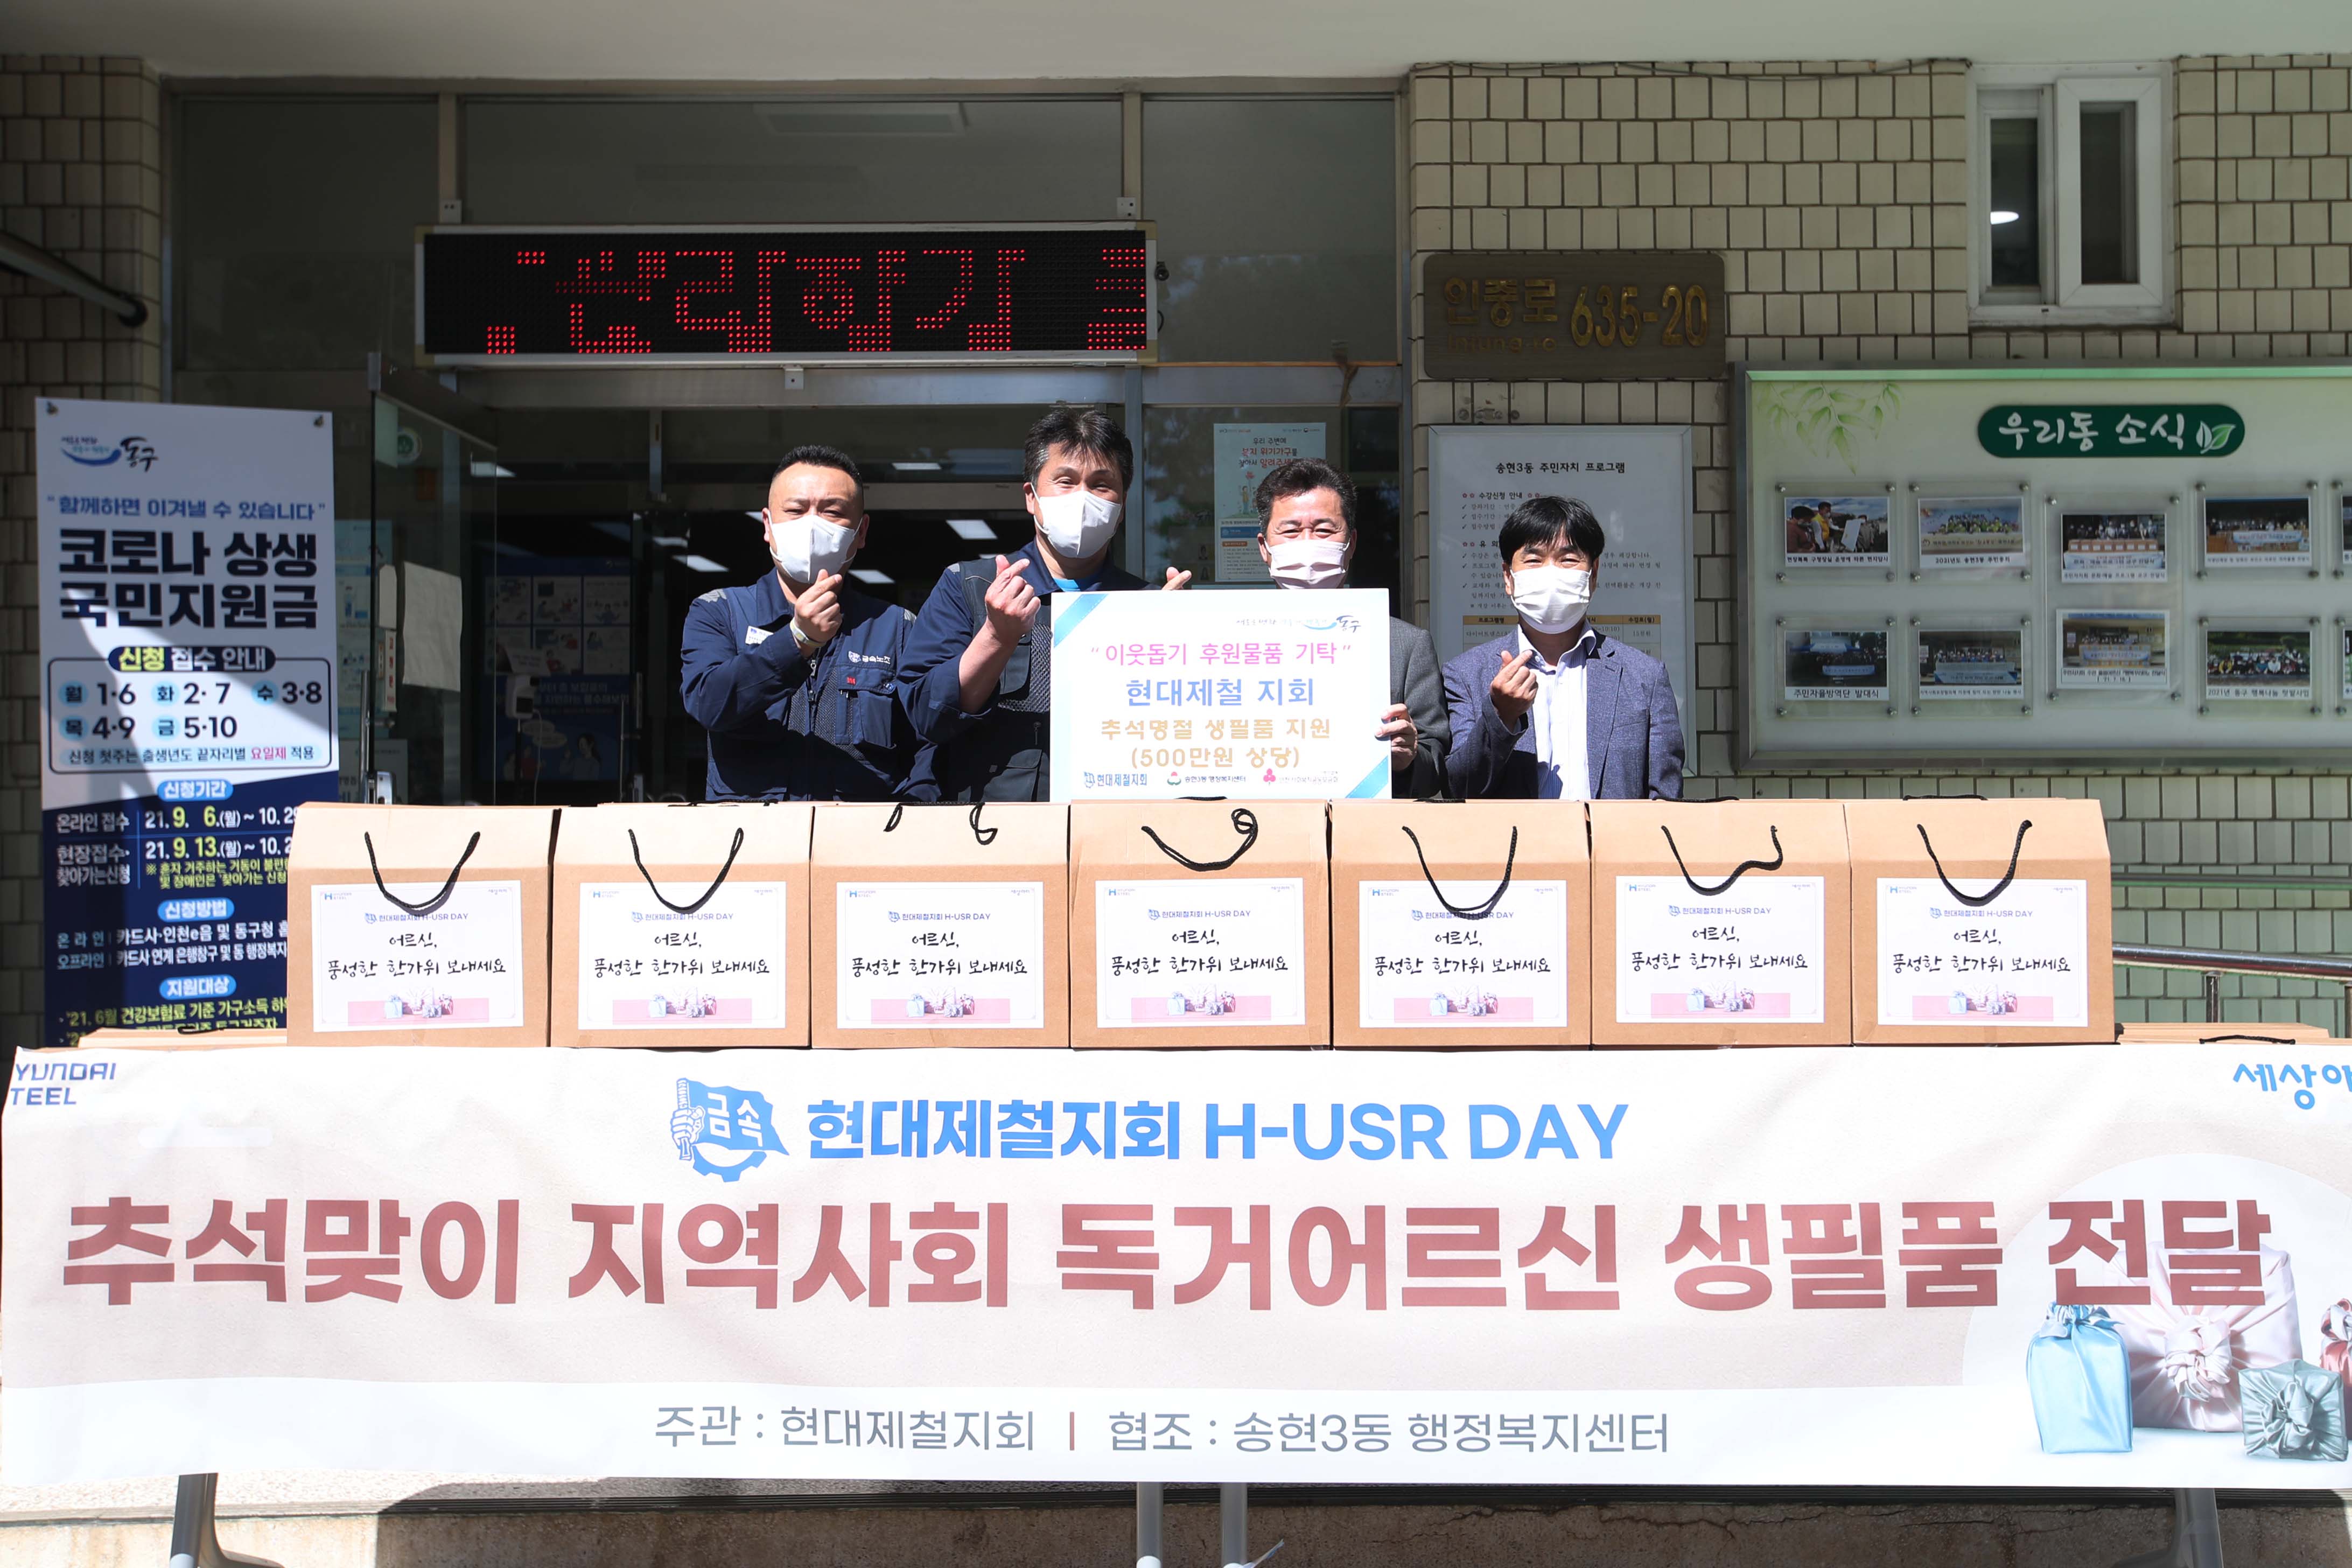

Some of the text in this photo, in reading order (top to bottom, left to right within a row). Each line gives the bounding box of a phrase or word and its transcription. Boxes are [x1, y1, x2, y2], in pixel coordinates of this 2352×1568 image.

[1444, 277, 1708, 347] 인중로 635-20
[1254, 437, 1286, 445] 우리 주변에
[1999, 412, 2185, 452] 우리동 소식
[120, 436, 160, 472] 동구
[1242, 447, 1297, 458] 복지 위기가구를
[1239, 459, 1257, 468] 찾아서
[1496, 461, 1626, 474] 송현3동 주민자치 프로그램
[1479, 492, 1523, 500] 수강신청 안내
[148, 499, 206, 518] 이겨낼
[213, 501, 232, 519] 수
[59, 529, 317, 577] 코로나 상생
[60, 583, 318, 629] 국민지원금
[118, 647, 266, 671] 신청 접수 안내
[1199, 642, 1283, 665] 후원물품
[65, 682, 136, 705] 월 1·6
[157, 685, 175, 702] 화
[257, 681, 323, 705] 수 3·8
[1126, 677, 1314, 706] 현대제철 지회
[1794, 689, 1880, 699] 주민자율방역단 발대식
[65, 717, 136, 740] 목 4·9
[157, 716, 237, 739] 금 5·10
[1101, 718, 1331, 741] 추석명절 생필품 지원
[69, 746, 314, 765] 신청 첫주는 출생년도 끝자리별 요일제 적용
[1131, 746, 1300, 769] (500만원 상당)
[1097, 773, 1147, 786] 현대제철지회
[1208, 775, 1247, 783] 행정복지센터
[164, 780, 227, 799] 신청기간
[56, 810, 130, 834] 온라인 접수
[160, 858, 261, 874] 혼자 거주하는 거동이
[159, 874, 171, 890] 및
[173, 873, 216, 889] 장애인은
[164, 901, 227, 919] 신청방법
[645, 913, 686, 921] 현대제철지회
[901, 913, 943, 921] 현대제철지회
[1161, 911, 1203, 919] 현대제철지회
[217, 923, 230, 941] 및
[235, 920, 274, 941] 동구청
[655, 932, 702, 948] 어르신,
[1172, 929, 1220, 946] 어르신,
[1435, 930, 1482, 947] 어르신,
[1692, 927, 1740, 942] 어르신,
[1954, 929, 2002, 945] 어르신,
[389, 933, 438, 948] 어르신,
[912, 932, 960, 949] 어르신,
[56, 951, 105, 970] 오프라인
[117, 948, 150, 967] 카드사
[151, 947, 174, 965] 연계
[176, 945, 218, 965] 은행창구
[220, 944, 231, 962] 및
[233, 943, 244, 961] 동
[1112, 955, 1289, 976] 풍성한 한가위 보내세요
[1375, 956, 1551, 976] 풍성한 한가위 보내세요
[1632, 952, 1809, 971] 풍성한 한가위 보내세요
[1893, 954, 2071, 973] 풍성한 한가위 보내세요
[328, 958, 506, 980] 풍성한 한가위 보내세요
[594, 958, 770, 978] 풍성한 한가위 보내세요
[852, 958, 1028, 977] 풍성한 한가위 보내세요
[166, 978, 230, 997] 지원대상
[121, 1003, 186, 1024] 건강보험료
[190, 1001, 214, 1019] 기준
[218, 998, 268, 1018] 가구소득
[16, 1062, 116, 1082] YUNDAI
[10, 1087, 78, 1106] TEEL
[707, 1091, 765, 1147] 금속
[808, 1100, 1629, 1161] 현대제철지회 H-USR DAY
[64, 1196, 2272, 1312] 추석맞이 지역사회 독거어르신 생필품 전달
[655, 1406, 1033, 1451] 주관 현대제철지회
[1109, 1411, 1668, 1453] 협조 송현3동 행정복지센터
